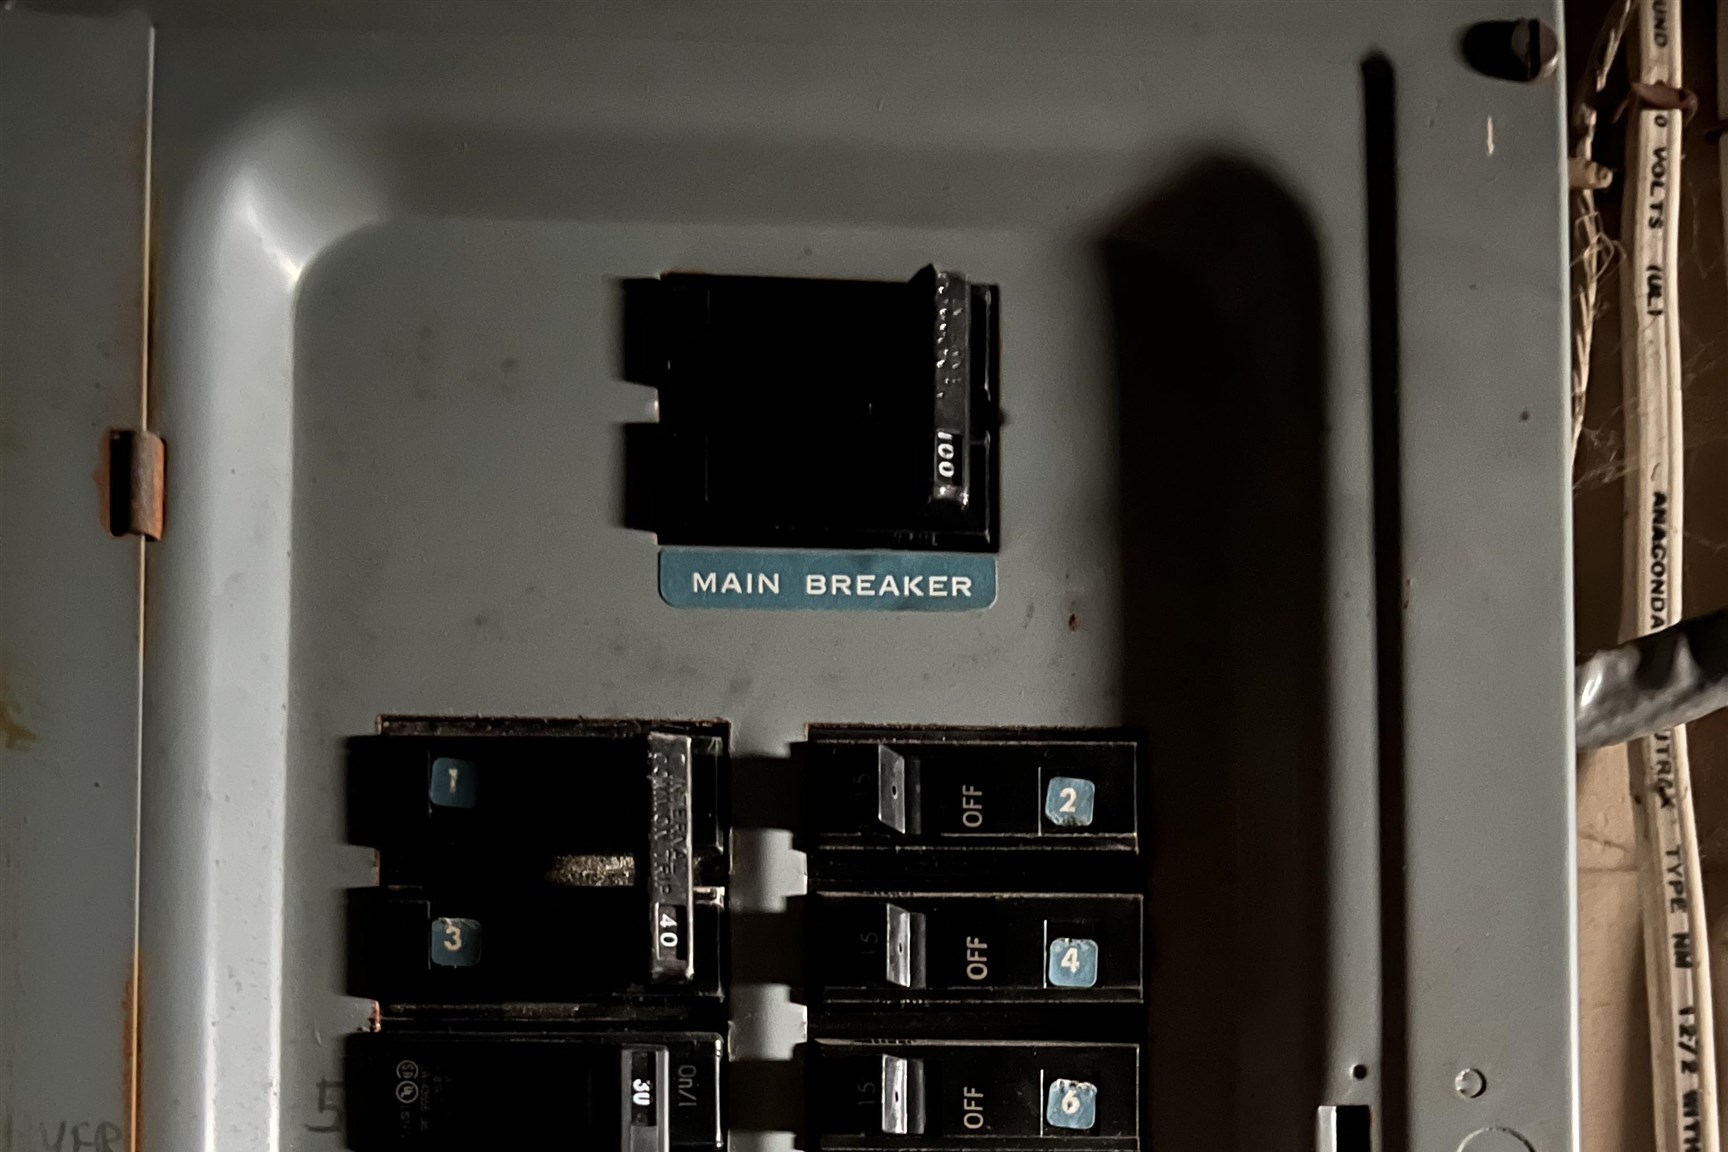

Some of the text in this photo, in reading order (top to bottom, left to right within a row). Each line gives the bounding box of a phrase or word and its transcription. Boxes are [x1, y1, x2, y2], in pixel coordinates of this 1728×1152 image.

[1650, 148, 1668, 230] VOLTS
[937, 430, 955, 477] 100
[1650, 491, 1666, 629] ANACONDA
[692, 572, 972, 597] MAIN BREAKER
[447, 768, 459, 793] 1
[961, 783, 983, 828] OFF
[1058, 787, 1077, 813] 2
[1665, 846, 1687, 914] TYPE
[443, 926, 463, 952] 3
[659, 913, 678, 948] 40
[966, 935, 988, 981] OFF
[1060, 947, 1080, 974] 4
[1672, 933, 1691, 969] NM
[963, 1085, 985, 1130] OFF
[1061, 1088, 1080, 1115] 6
